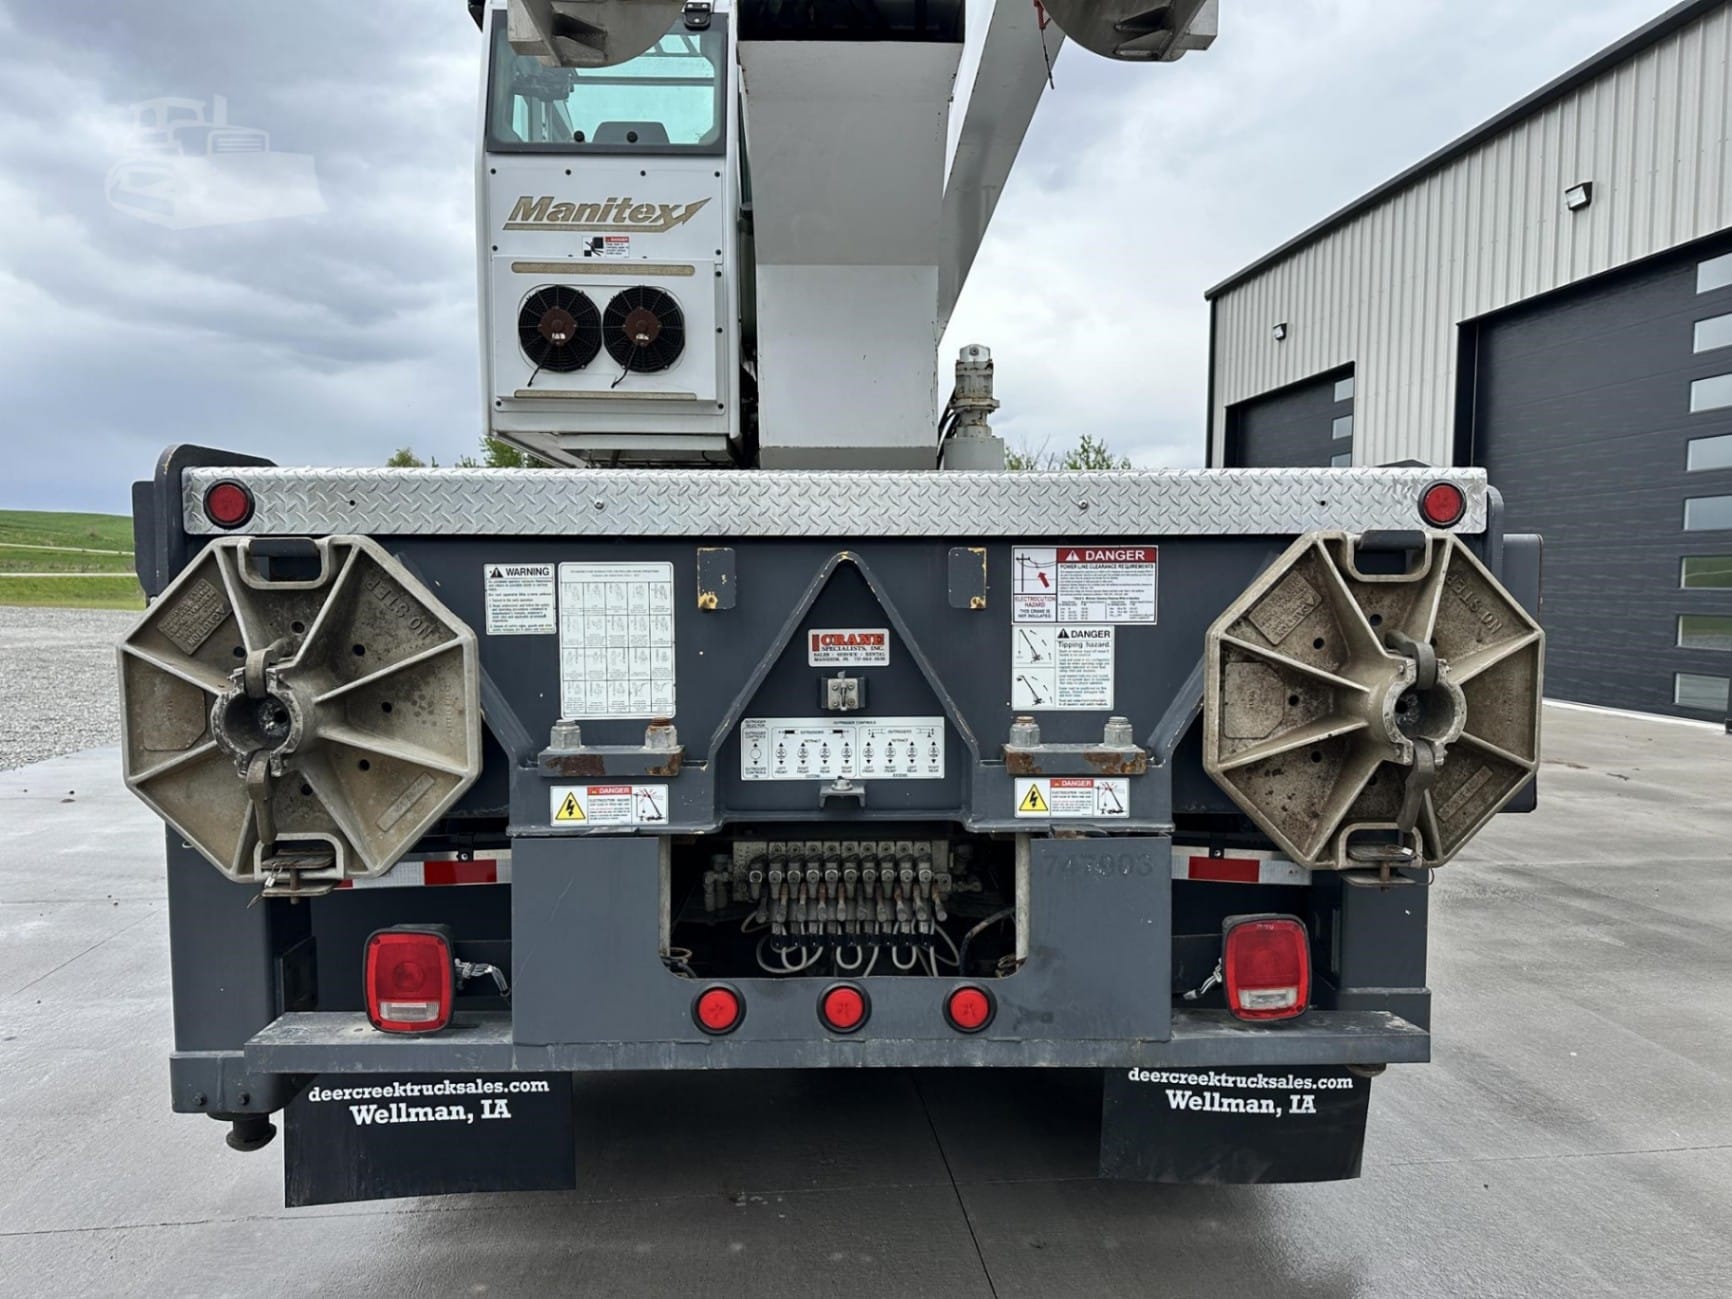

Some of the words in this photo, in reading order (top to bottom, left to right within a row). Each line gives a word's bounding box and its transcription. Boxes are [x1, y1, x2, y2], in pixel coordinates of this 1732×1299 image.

[507, 195, 689, 225] Manitex
[1085, 550, 1145, 561] DANGER
[505, 567, 550, 577] WARNING
[365, 579, 410, 618] STEP
[1445, 574, 1481, 613] STEP
[408, 615, 434, 641] NO
[1071, 630, 1111, 638] DANGER
[1480, 610, 1504, 635] NO
[820, 633, 885, 646] CRANE
[1057, 641, 1083, 649] Tipping
[308, 1079, 550, 1102] deercreektrucksales.com
[1128, 1067, 1354, 1090] deercreektrucksales.com
[350, 1103, 475, 1125] Wellman,
[480, 1099, 512, 1119] IA
[1165, 1089, 1283, 1118] Wellman,
[1288, 1094, 1317, 1114] IA
